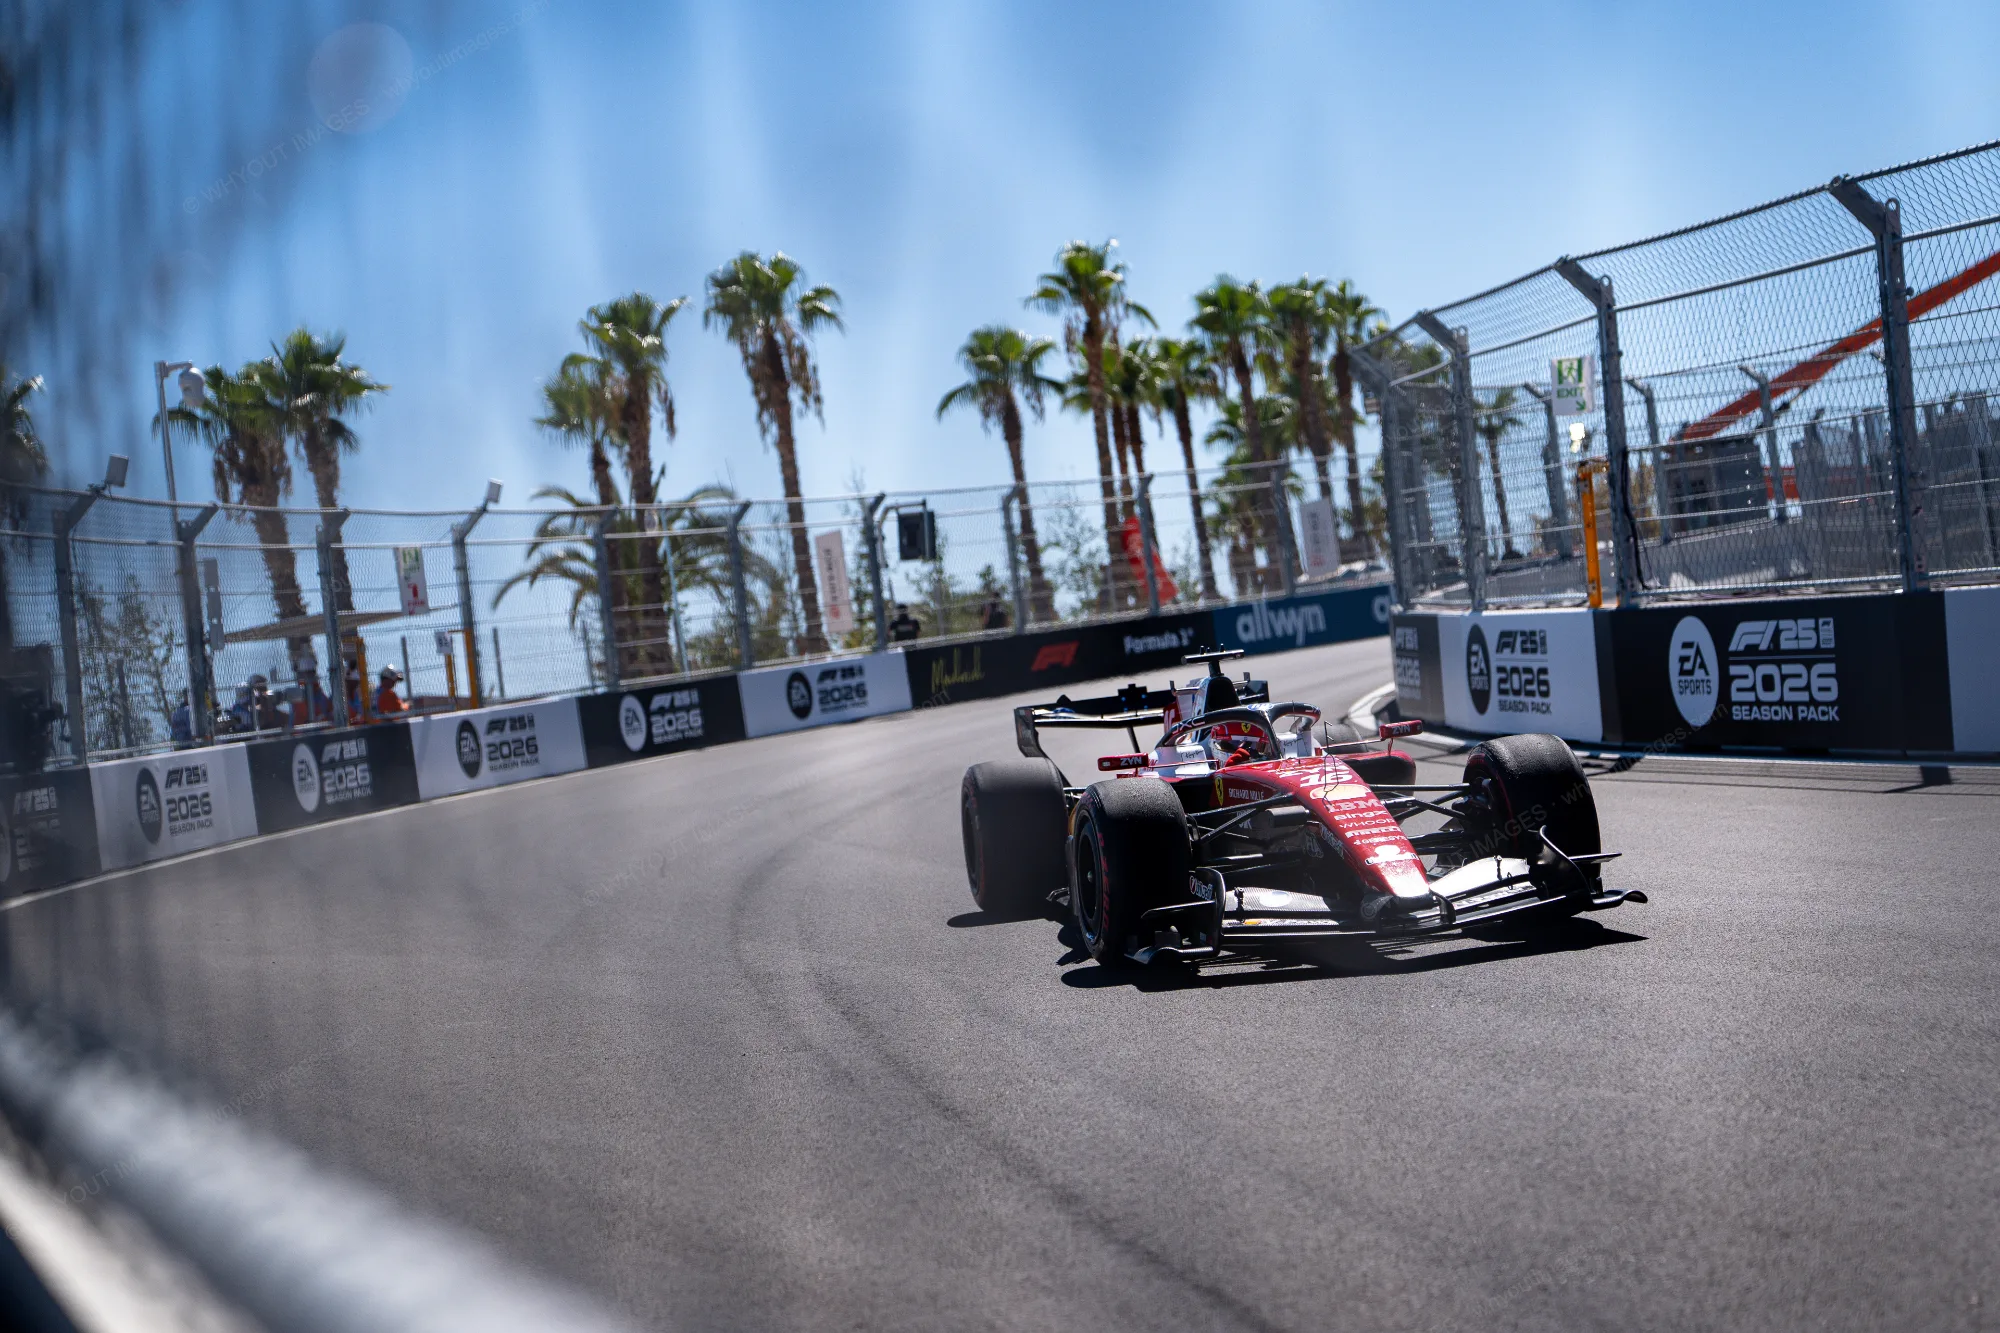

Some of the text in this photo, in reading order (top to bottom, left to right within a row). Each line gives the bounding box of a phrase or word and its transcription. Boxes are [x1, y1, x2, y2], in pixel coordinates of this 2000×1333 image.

[1557, 386, 1585, 398] EXIT
[1237, 602, 1326, 646] allwyn
[1779, 618, 1817, 650] 25
[1124, 631, 1180, 655] Formula
[1518, 629, 1539, 654] 25
[1031, 641, 1080, 671] F1
[1470, 643, 1488, 675] EA
[1678, 641, 1710, 676] EA
[818, 682, 868, 705] 2026
[1496, 666, 1550, 698] 2026
[1678, 679, 1712, 695] SPORTS
[1728, 662, 1838, 702] 2026
[1499, 698, 1552, 714] SEASON PACK
[1732, 705, 1840, 721] SEASON PACK
[651, 709, 702, 734] 2026
[1392, 724, 1410, 734] ZYN
[487, 736, 538, 761] 2026
[1120, 756, 1142, 766] ZYN
[323, 762, 371, 793] 2026
[1300, 770, 1352, 788] 16
[166, 791, 212, 822] 2026
[1327, 799, 1380, 813] IBM
[169, 818, 213, 837] SEASON PACK
